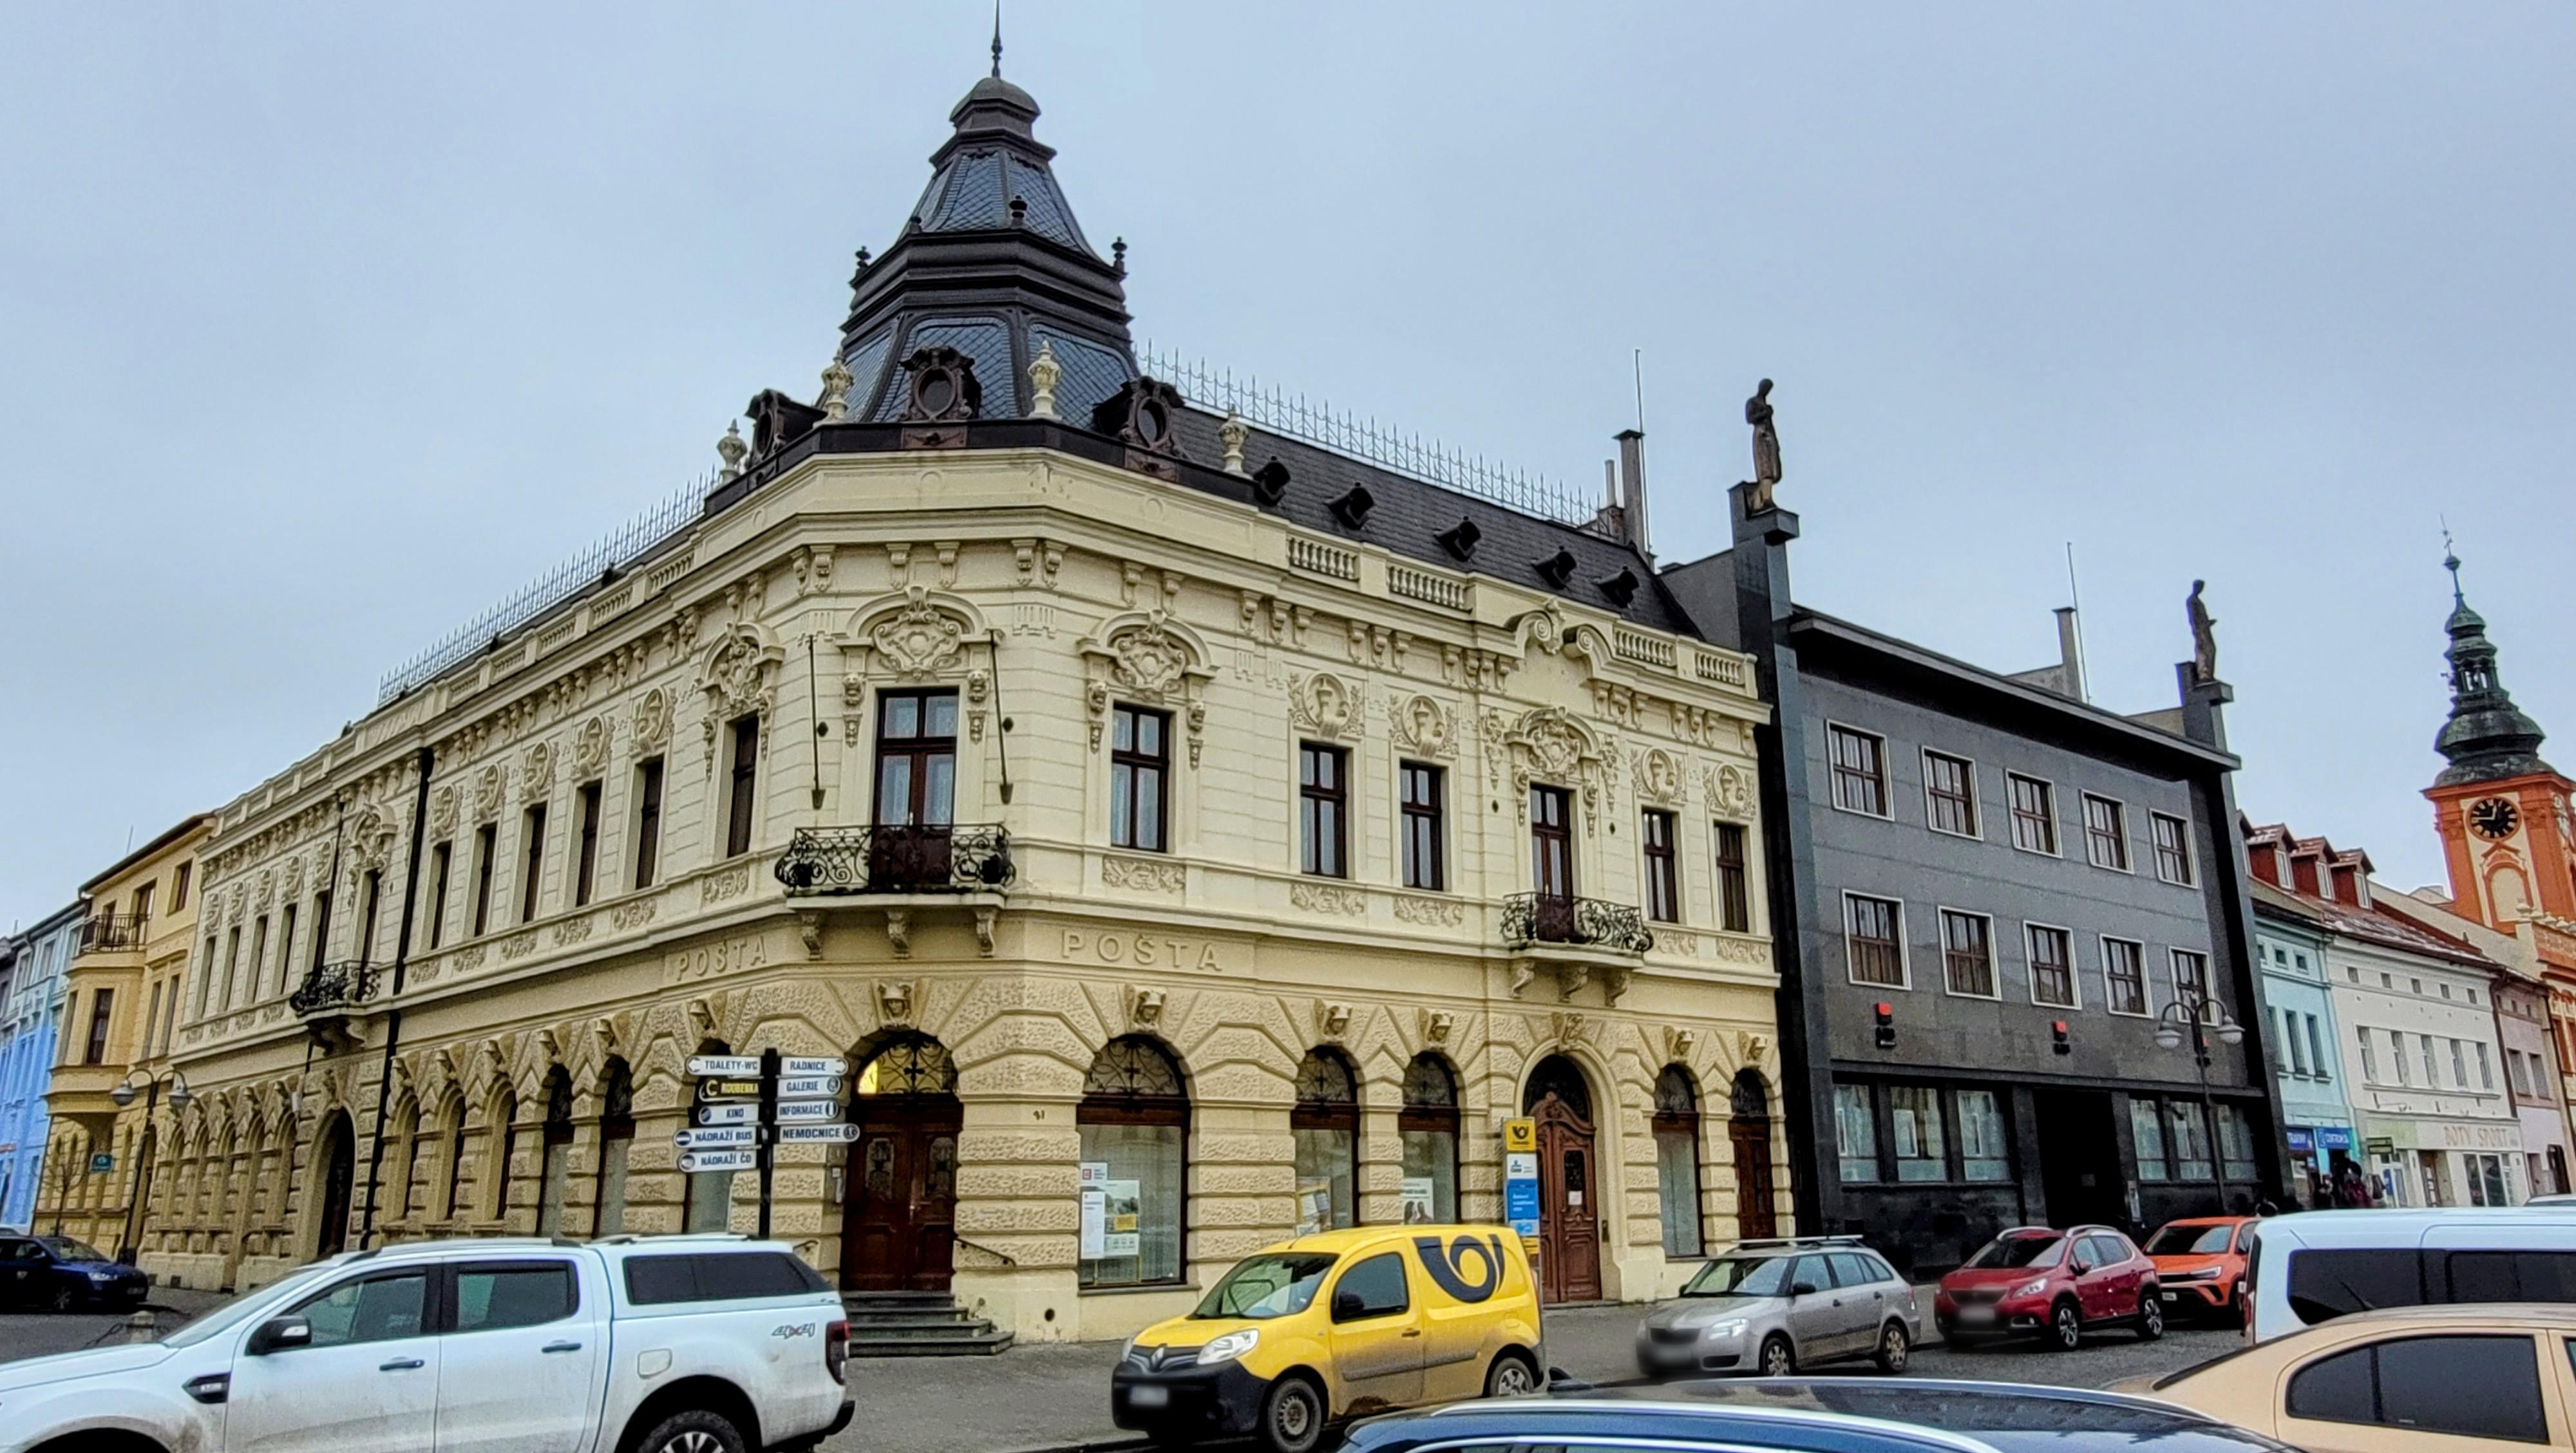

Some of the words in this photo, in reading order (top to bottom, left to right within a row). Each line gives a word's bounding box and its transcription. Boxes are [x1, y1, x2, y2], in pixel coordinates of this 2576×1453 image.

[1061, 929, 1222, 972] POŠTA
[676, 935, 767, 982] POŠTA
[705, 1060, 758, 1070] TOALETY-WC
[790, 1061, 826, 1070] RADNICE
[786, 1080, 819, 1092] GALERIE
[726, 1108, 744, 1118] KINO
[779, 1104, 823, 1116] INFORMACE
[695, 1130, 733, 1142] NÁDRAŽÍ
[735, 1131, 753, 1141] BUS
[782, 1127, 840, 1139] NEMOCNICE
[701, 1153, 737, 1166] NÁDRAŽÍ
